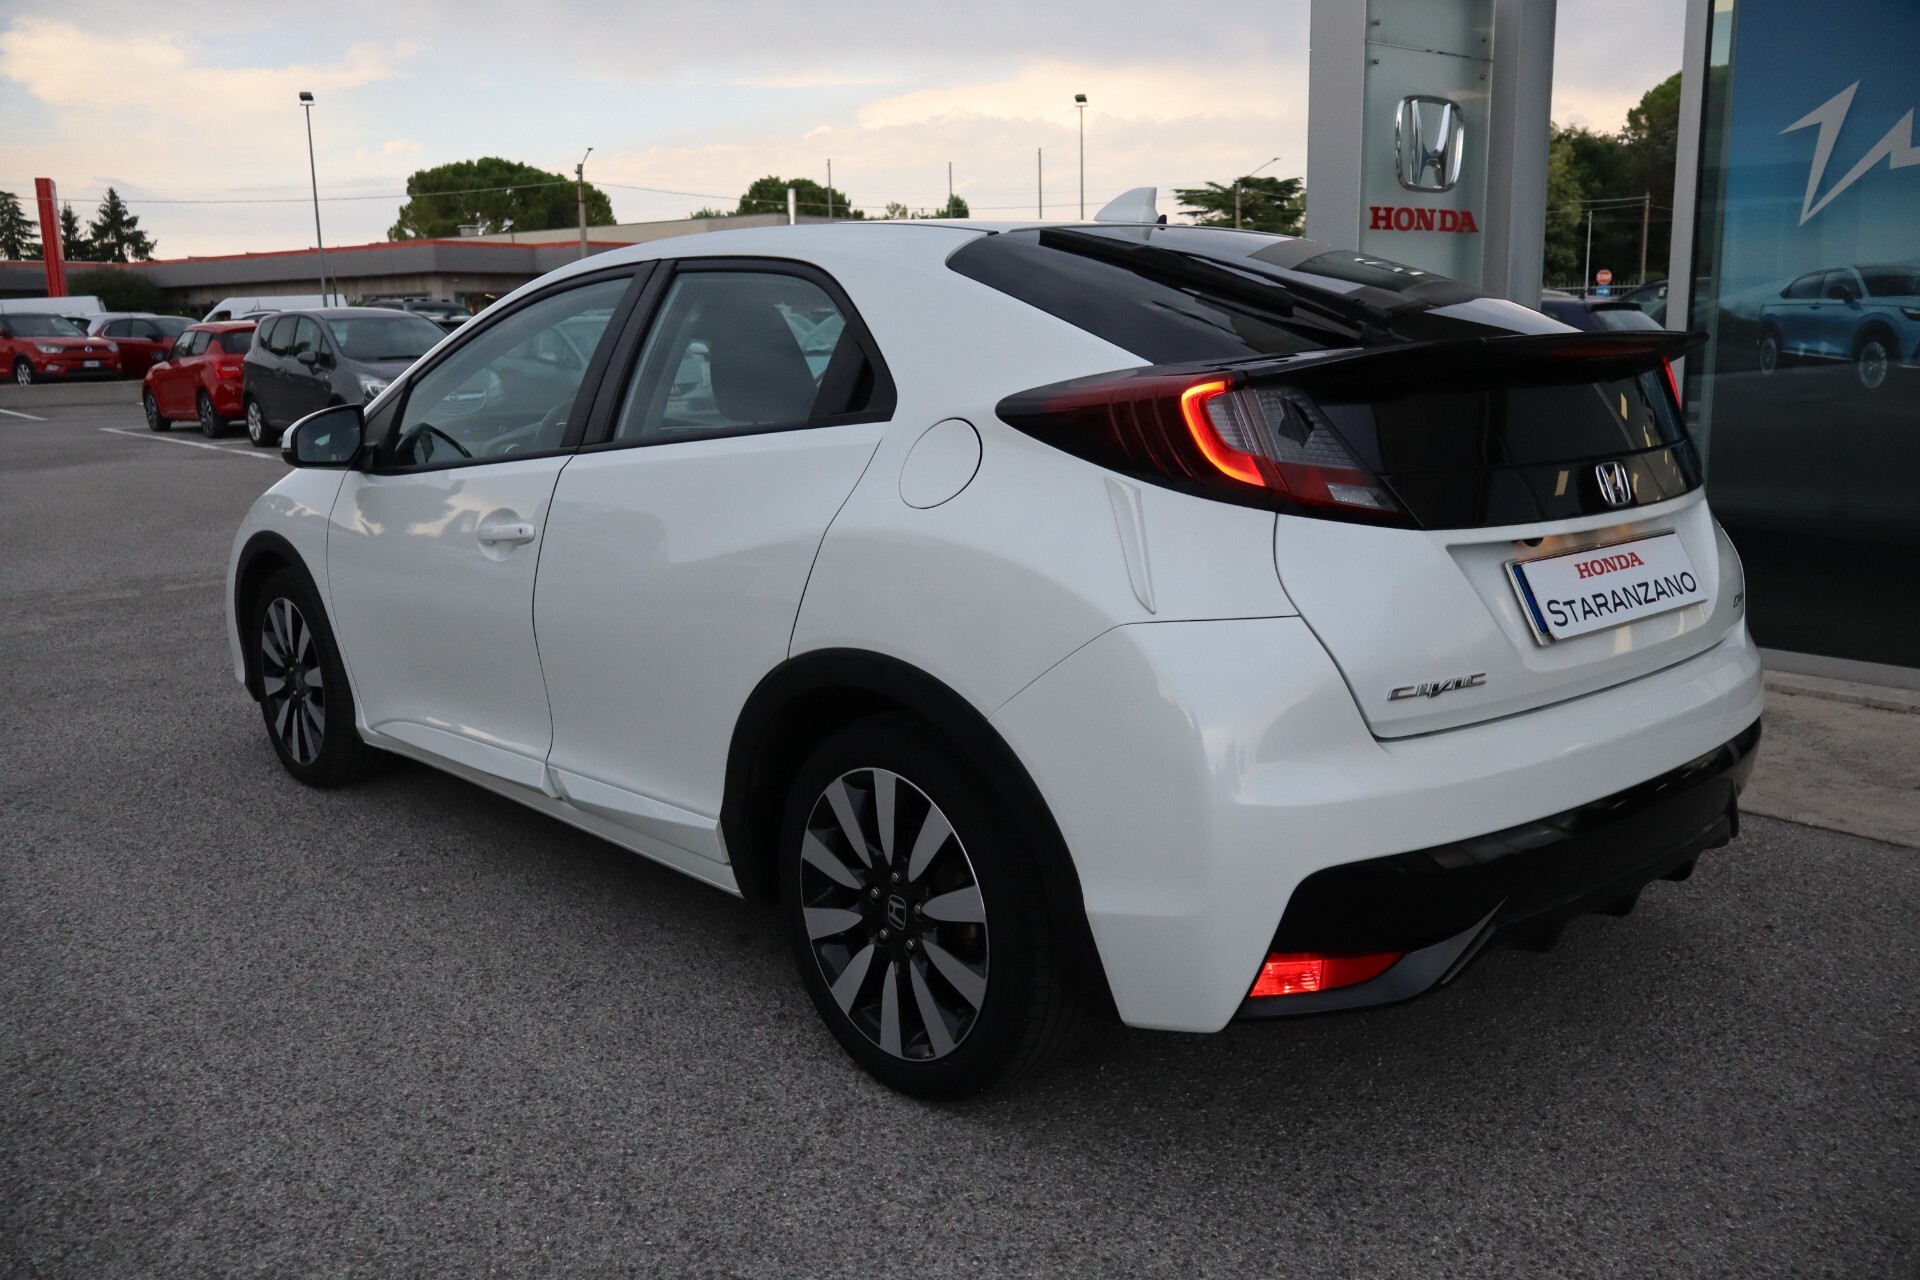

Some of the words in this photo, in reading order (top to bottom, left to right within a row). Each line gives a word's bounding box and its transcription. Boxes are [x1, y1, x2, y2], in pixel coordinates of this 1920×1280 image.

[1369, 206, 1479, 233] HONDA
[1574, 551, 1644, 579] HONDA
[1547, 571, 1696, 627] STARANZANO
[1387, 672, 1487, 701] CIVIC
